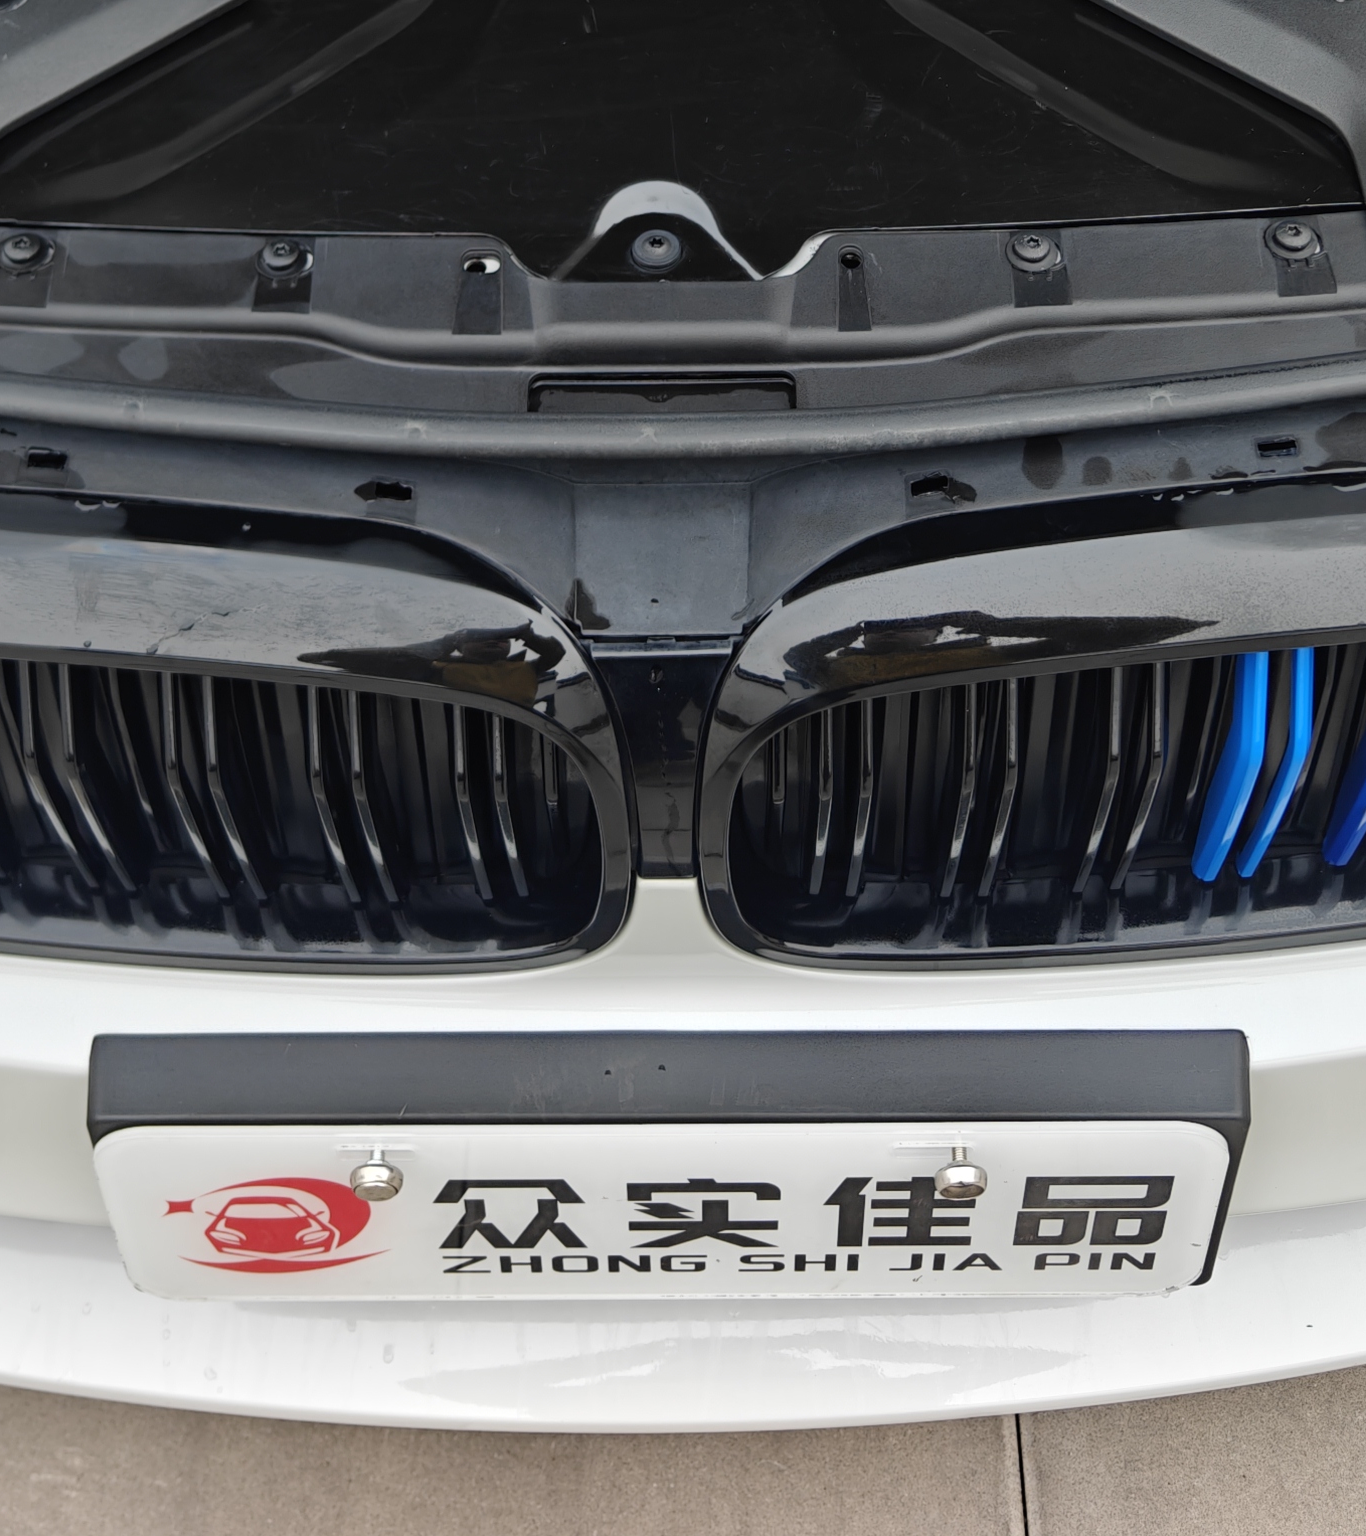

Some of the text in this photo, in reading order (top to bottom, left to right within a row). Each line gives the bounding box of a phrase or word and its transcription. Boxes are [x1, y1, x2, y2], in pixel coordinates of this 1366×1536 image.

[433, 1175, 1176, 1249] 众实佳品
[442, 1252, 1156, 1274] ZHONG SHI JIA PIN
